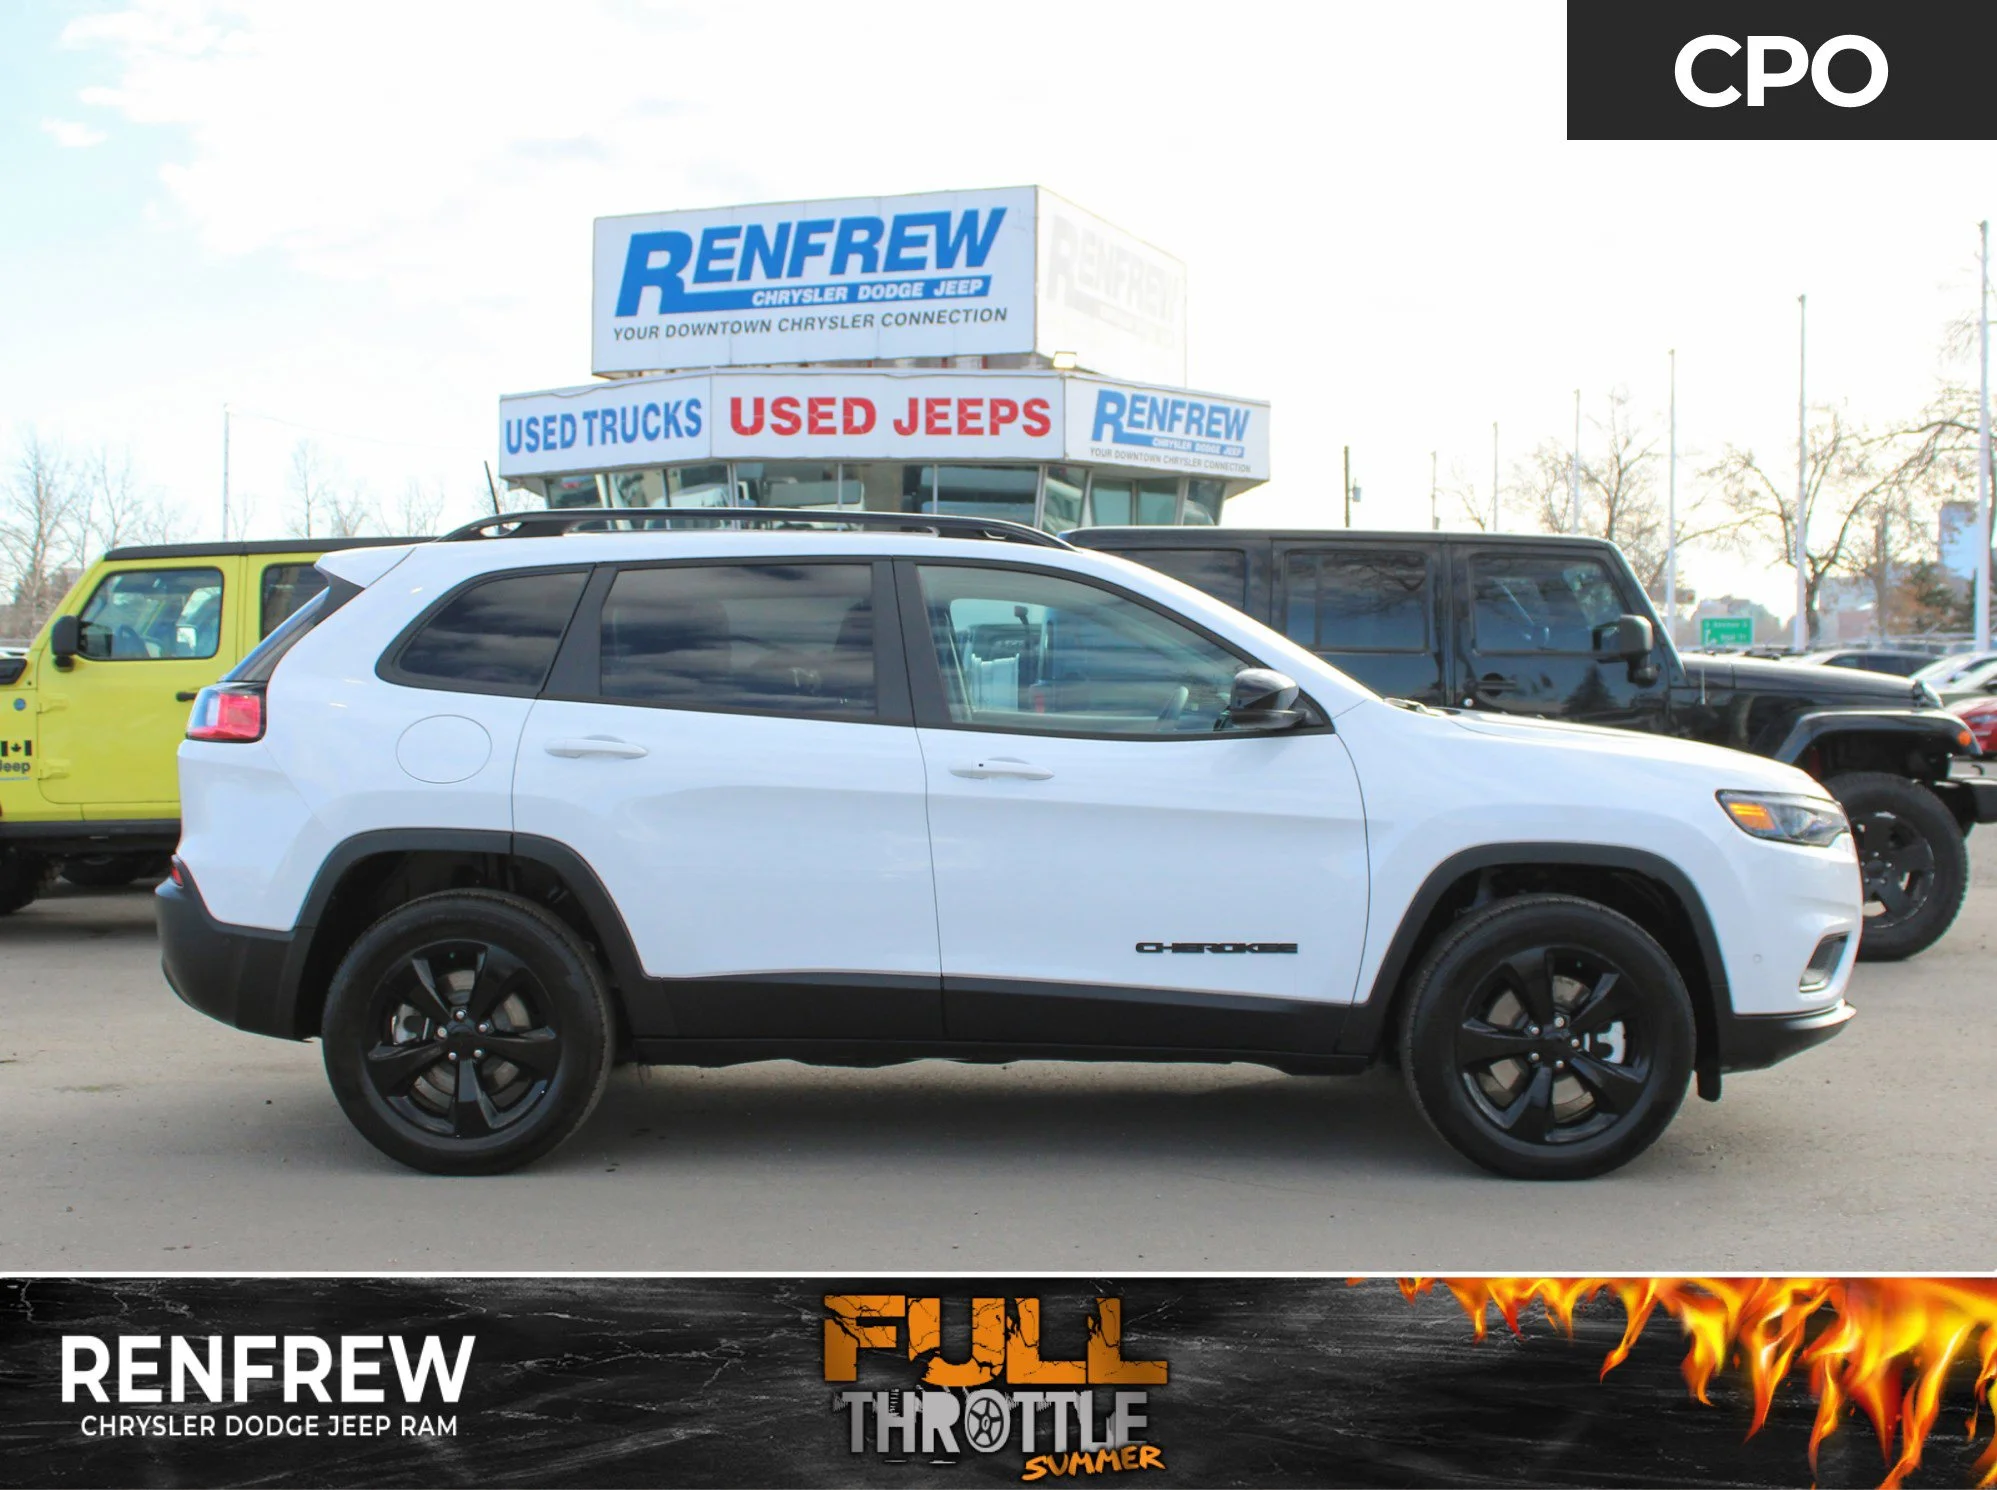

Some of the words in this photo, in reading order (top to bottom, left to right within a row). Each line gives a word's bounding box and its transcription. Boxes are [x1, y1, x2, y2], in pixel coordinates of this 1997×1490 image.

[615, 207, 1007, 317] RENFREW
[752, 286, 848, 307] CHRYSLER
[857, 282, 924, 301] DODGE
[933, 279, 983, 297] JEEP
[613, 326, 660, 341] YOUR
[665, 320, 771, 339] DOWNTOWN
[778, 313, 875, 333] CHRYSLER
[881, 307, 1008, 328] CONNECTION
[505, 413, 577, 455] USED
[583, 398, 702, 447] TRUCKS
[729, 397, 877, 436] USED
[892, 397, 1052, 438] JEEPS
[1091, 389, 1250, 441] RENFREW
[1090, 447, 1113, 458] YOUR
[1114, 449, 1162, 463] DOWNTOWN
[1163, 454, 1202, 468] CHRYSLER
[1203, 459, 1252, 473] CONNECTION
[1136, 942, 1298, 954] CHEROKEE
